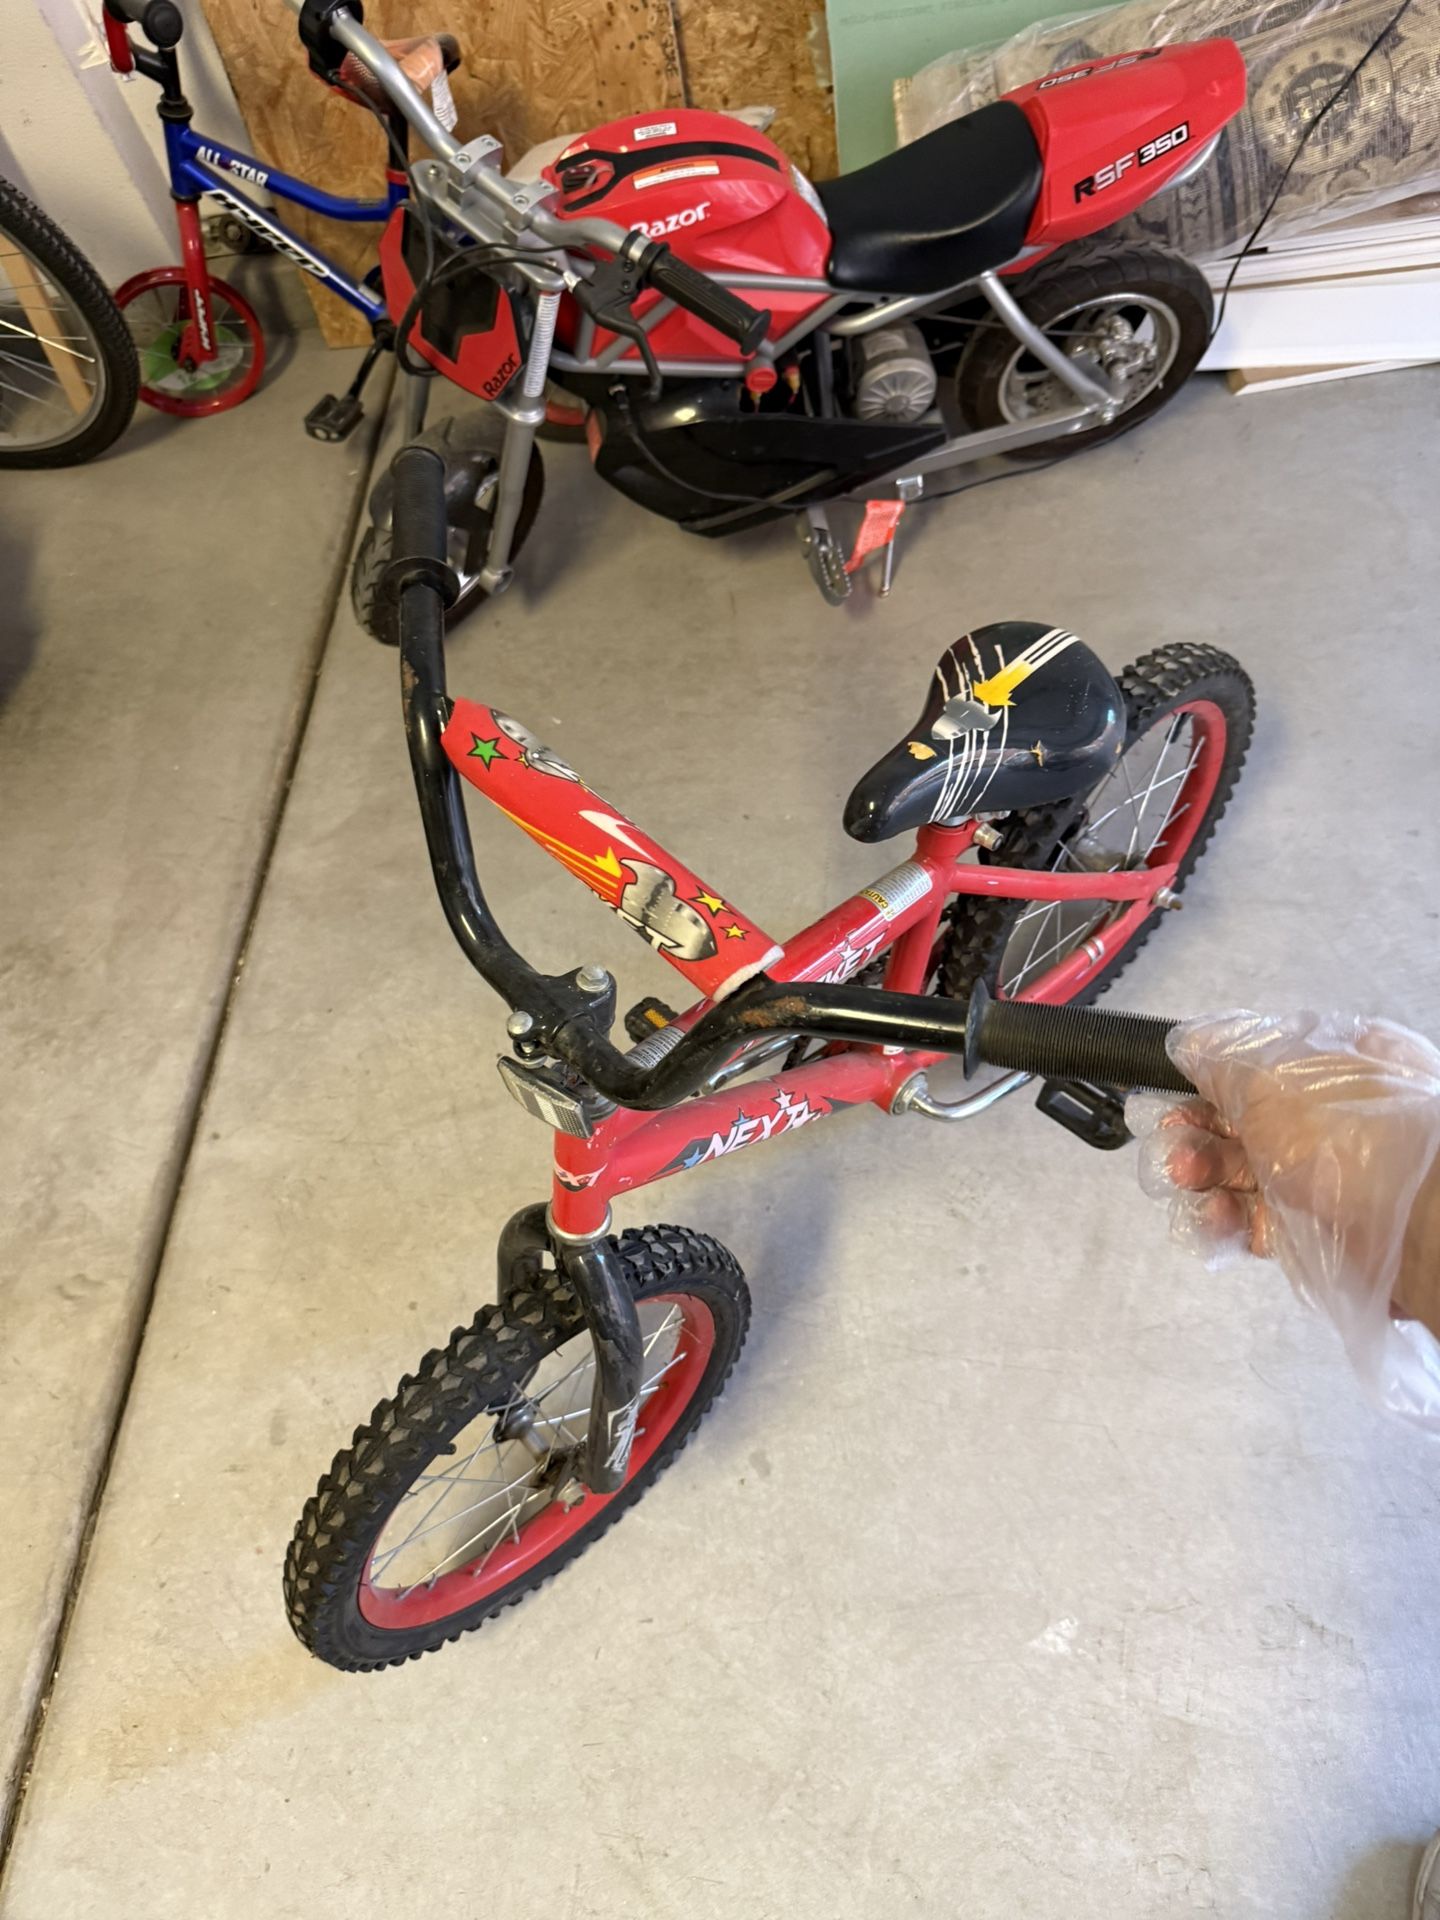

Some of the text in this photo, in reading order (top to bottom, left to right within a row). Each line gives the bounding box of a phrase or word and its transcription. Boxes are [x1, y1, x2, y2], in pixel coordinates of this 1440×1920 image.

[196, 146, 220, 165] ALL
[1073, 120, 1190, 204] RSF 350
[482, 353, 517, 397] Razor
[697, 1101, 809, 1165] NEXT
